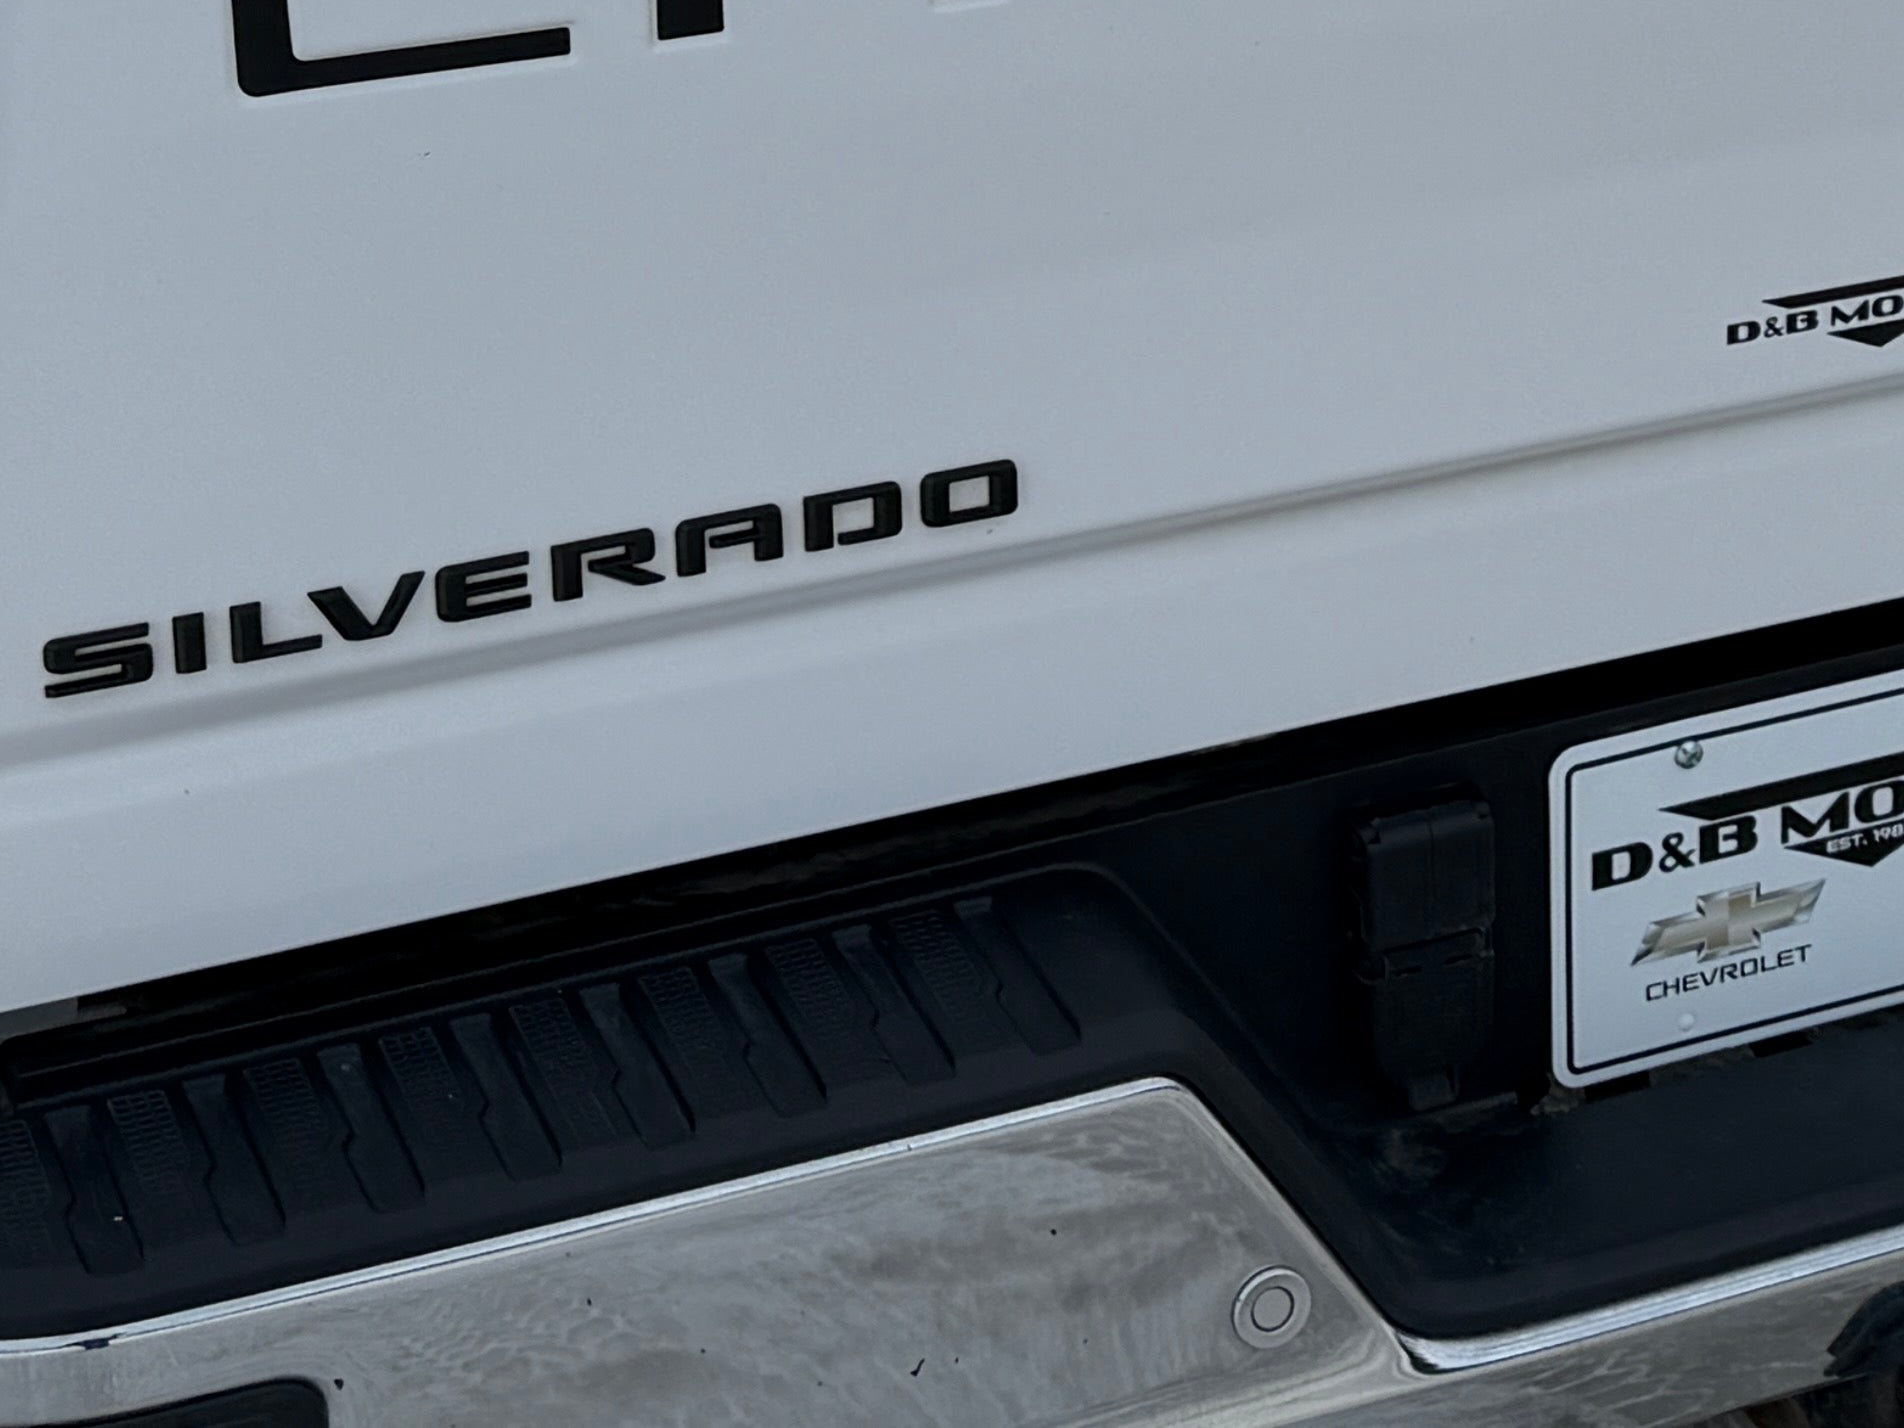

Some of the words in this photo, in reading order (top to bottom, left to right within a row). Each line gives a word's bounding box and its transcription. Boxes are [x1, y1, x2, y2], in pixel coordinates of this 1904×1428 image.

[1726, 308, 1820, 346] D&B
[42, 457, 1019, 699] SILVERADO
[1591, 814, 1759, 891] D&B
[1825, 832, 1869, 854] EST.
[1644, 943, 1813, 1003] CHEVROLET
